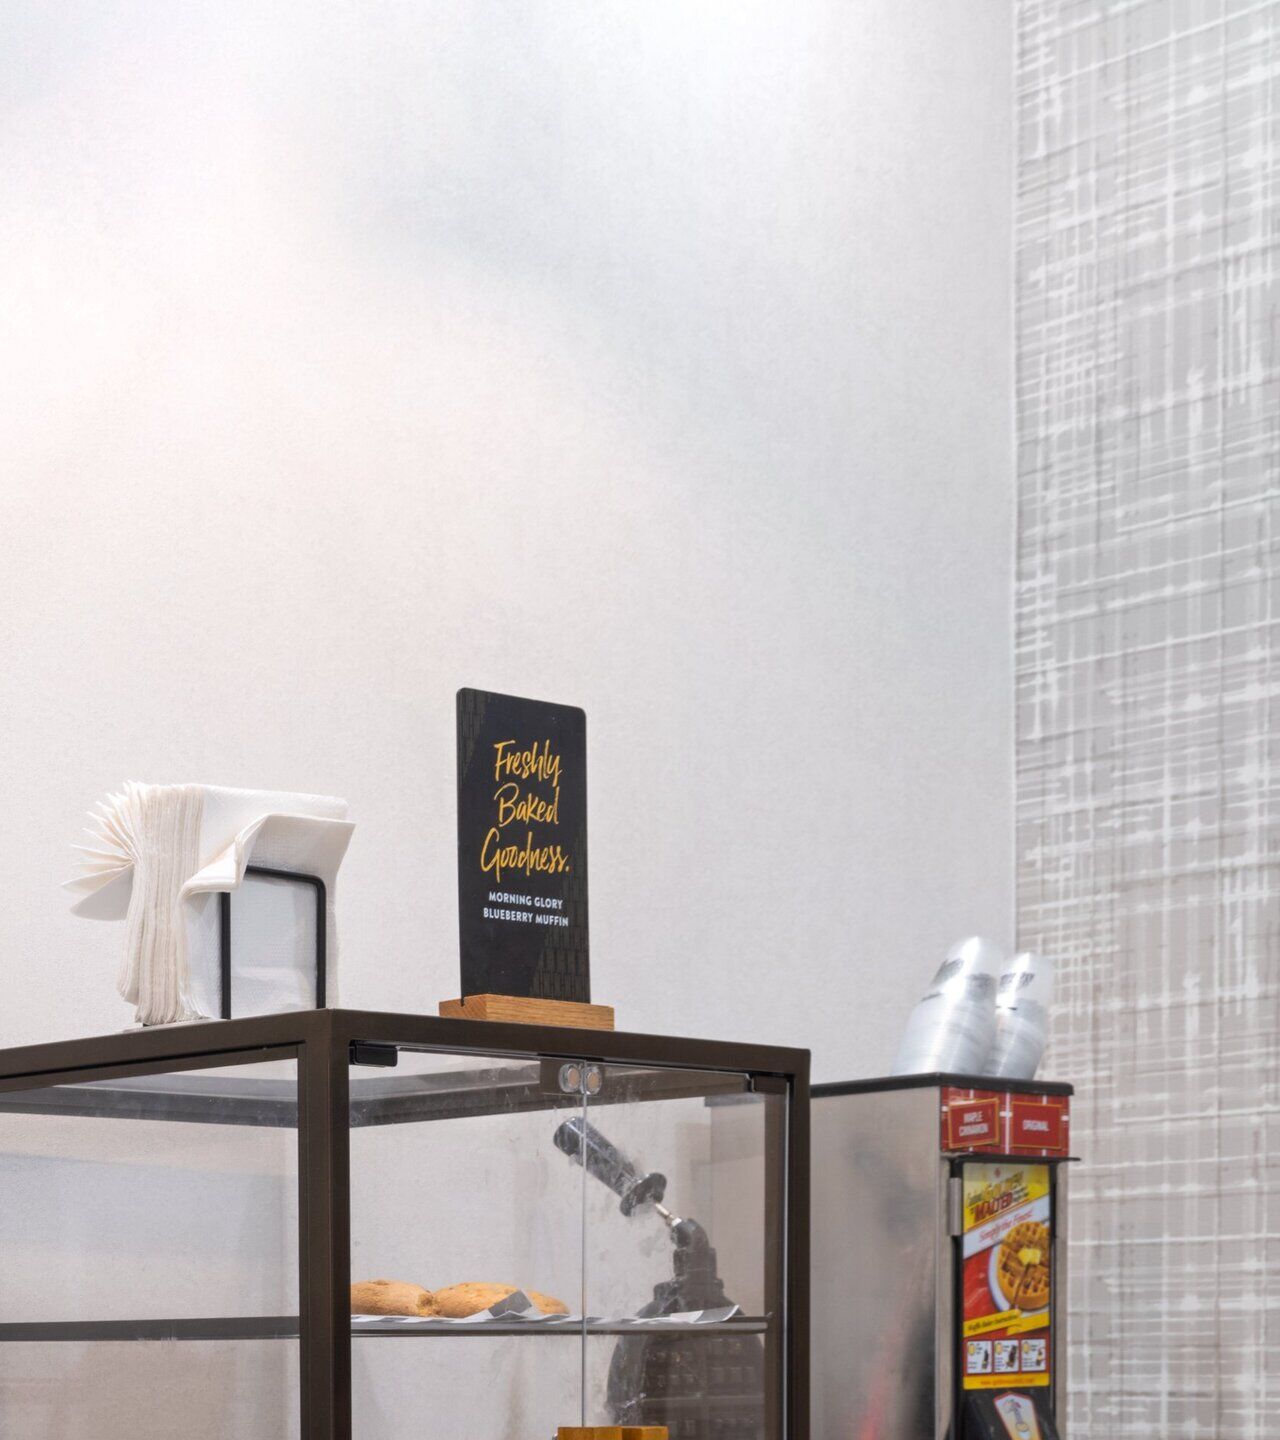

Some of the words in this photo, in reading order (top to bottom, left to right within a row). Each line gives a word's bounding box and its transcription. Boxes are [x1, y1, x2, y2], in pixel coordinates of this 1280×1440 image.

[493, 739, 563, 788] Freshly
[493, 782, 560, 827] Baked
[480, 827, 570, 883] Goodness.
[483, 907, 533, 923] BLUEBERRY
[535, 914, 569, 927] MUFFIN
[488, 891, 532, 906] MORNING
[534, 896, 563, 909] GLORY
